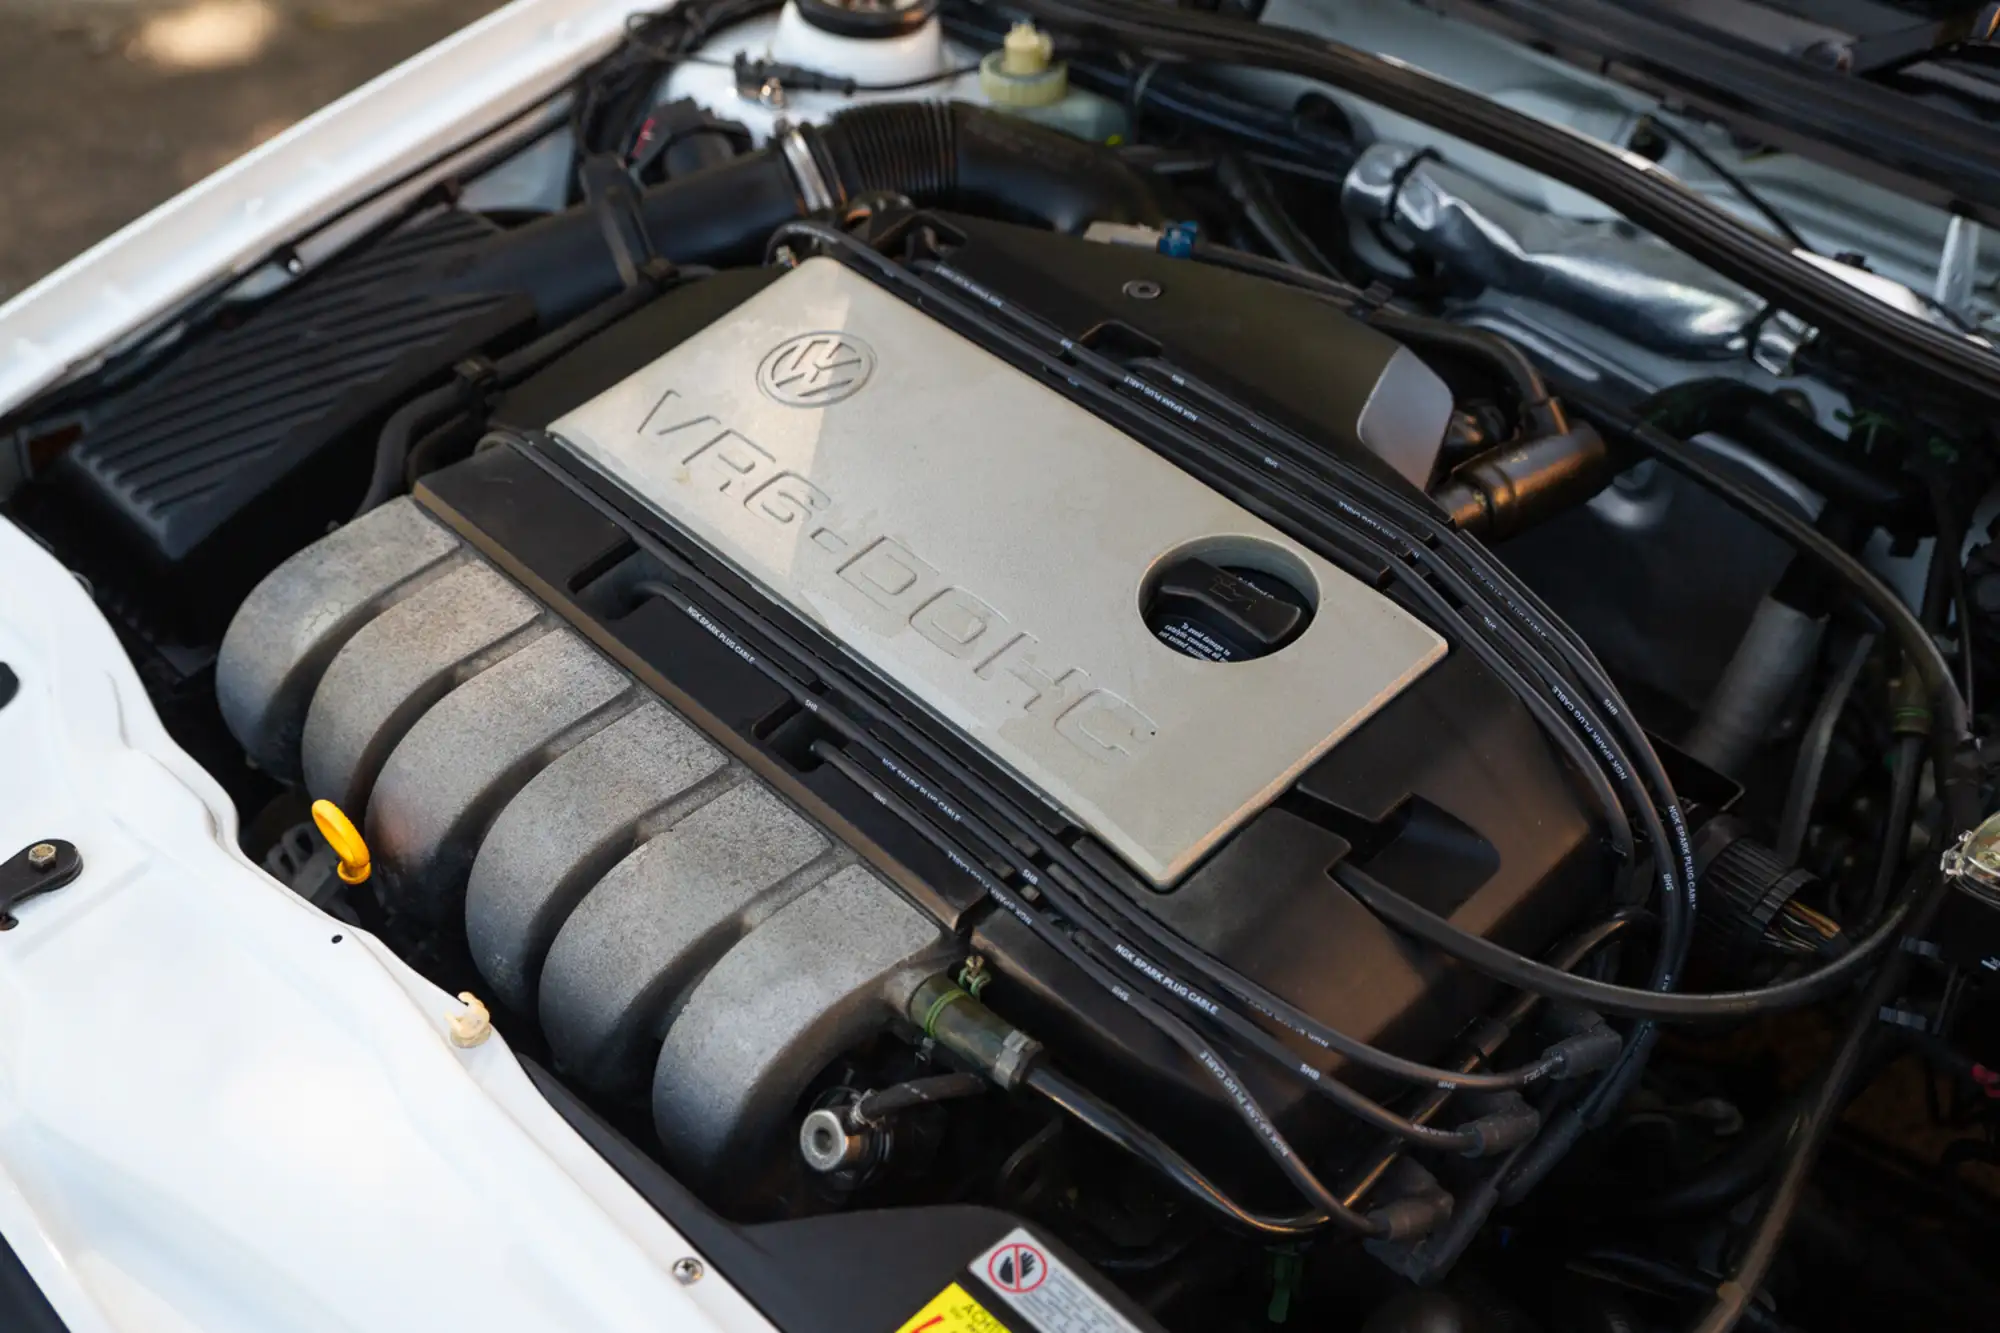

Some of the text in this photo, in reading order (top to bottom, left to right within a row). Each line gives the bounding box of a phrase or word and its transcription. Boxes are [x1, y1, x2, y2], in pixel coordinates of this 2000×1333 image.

[1144, 387, 1162, 400] PLUG
[687, 606, 755, 663] NGK SPARK PLUG CABLE
[1188, 627, 1204, 638] avoid
[1202, 636, 1224, 651] damage
[1551, 684, 1628, 779] NGK SPARK PLUG CABLE
[937, 801, 961, 821] CABLE
[1668, 805, 1681, 824] NGK
[1676, 826, 1690, 854] SPARK
[1683, 856, 1695, 880] PLUG
[1014, 908, 1032, 924] NGK
[1115, 944, 1218, 1015] NGK SPARK PLUG CABLE
[1199, 1050, 1225, 1079] CABLE
[1223, 1077, 1246, 1104] PLUG
